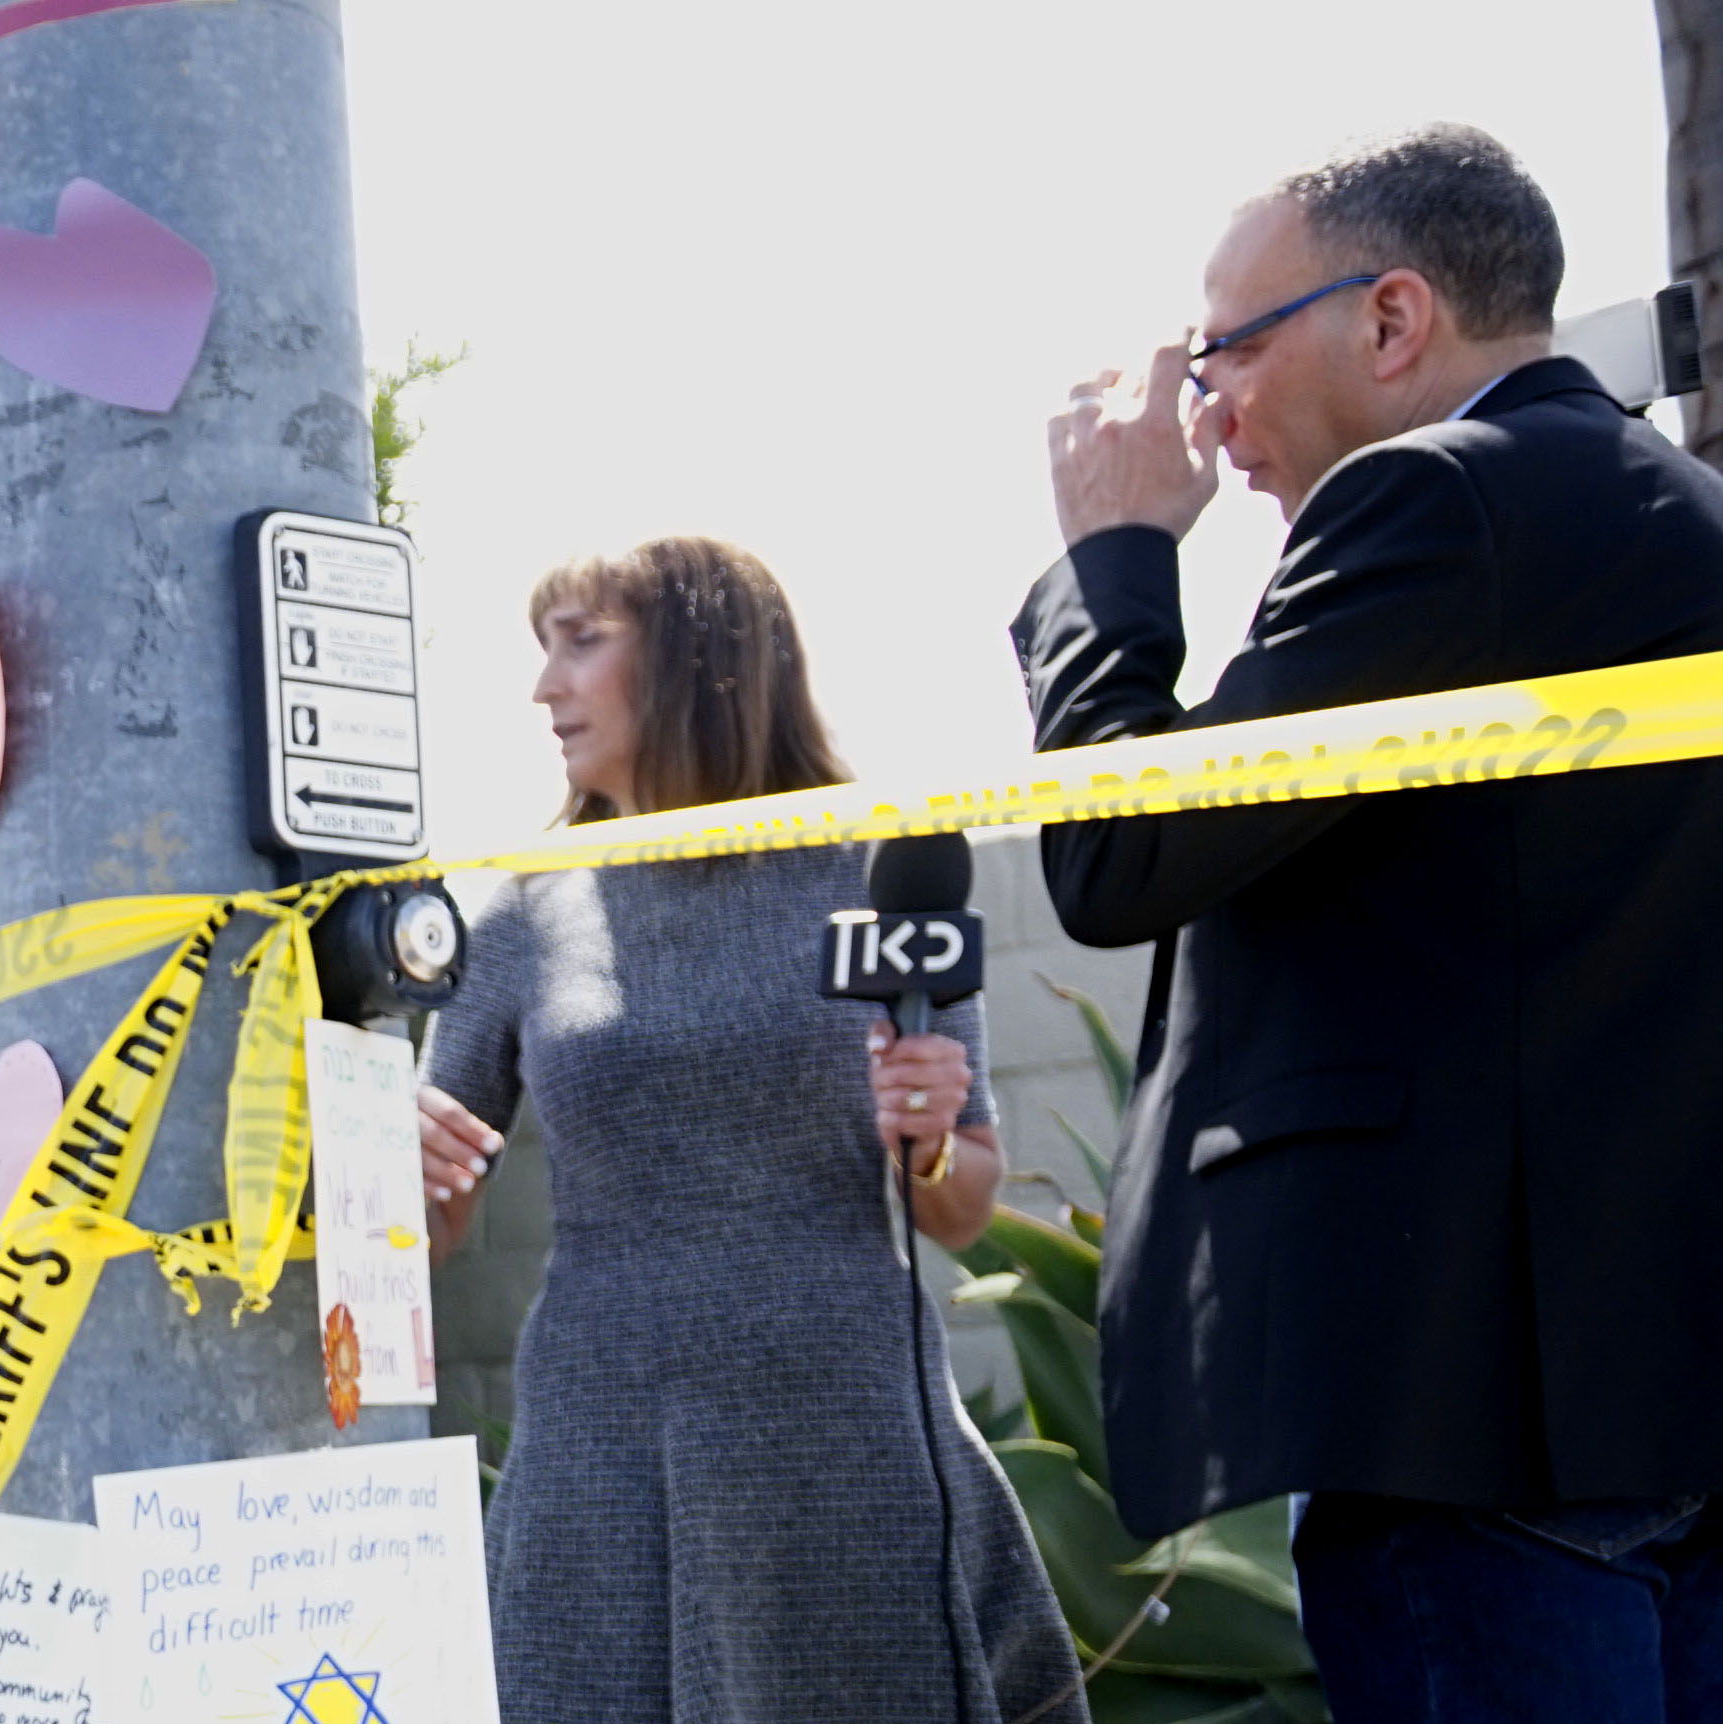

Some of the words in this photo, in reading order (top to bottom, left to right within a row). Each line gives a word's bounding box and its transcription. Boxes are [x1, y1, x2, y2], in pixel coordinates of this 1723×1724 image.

[325, 770, 341, 785] TO
[343, 771, 383, 791] CROSS
[314, 812, 347, 829] PUSH
[350, 816, 397, 834] BUTTON
[132, 1489, 202, 1552] May
[307, 1474, 403, 1514] wisdom
[409, 1476, 437, 1508] and
[48, 1578, 63, 1605] &
[141, 1562, 222, 1614] peace
[249, 1536, 338, 1591] prevail
[348, 1533, 411, 1577] during
[417, 1531, 447, 1558] this
[149, 1601, 282, 1655] difficult
